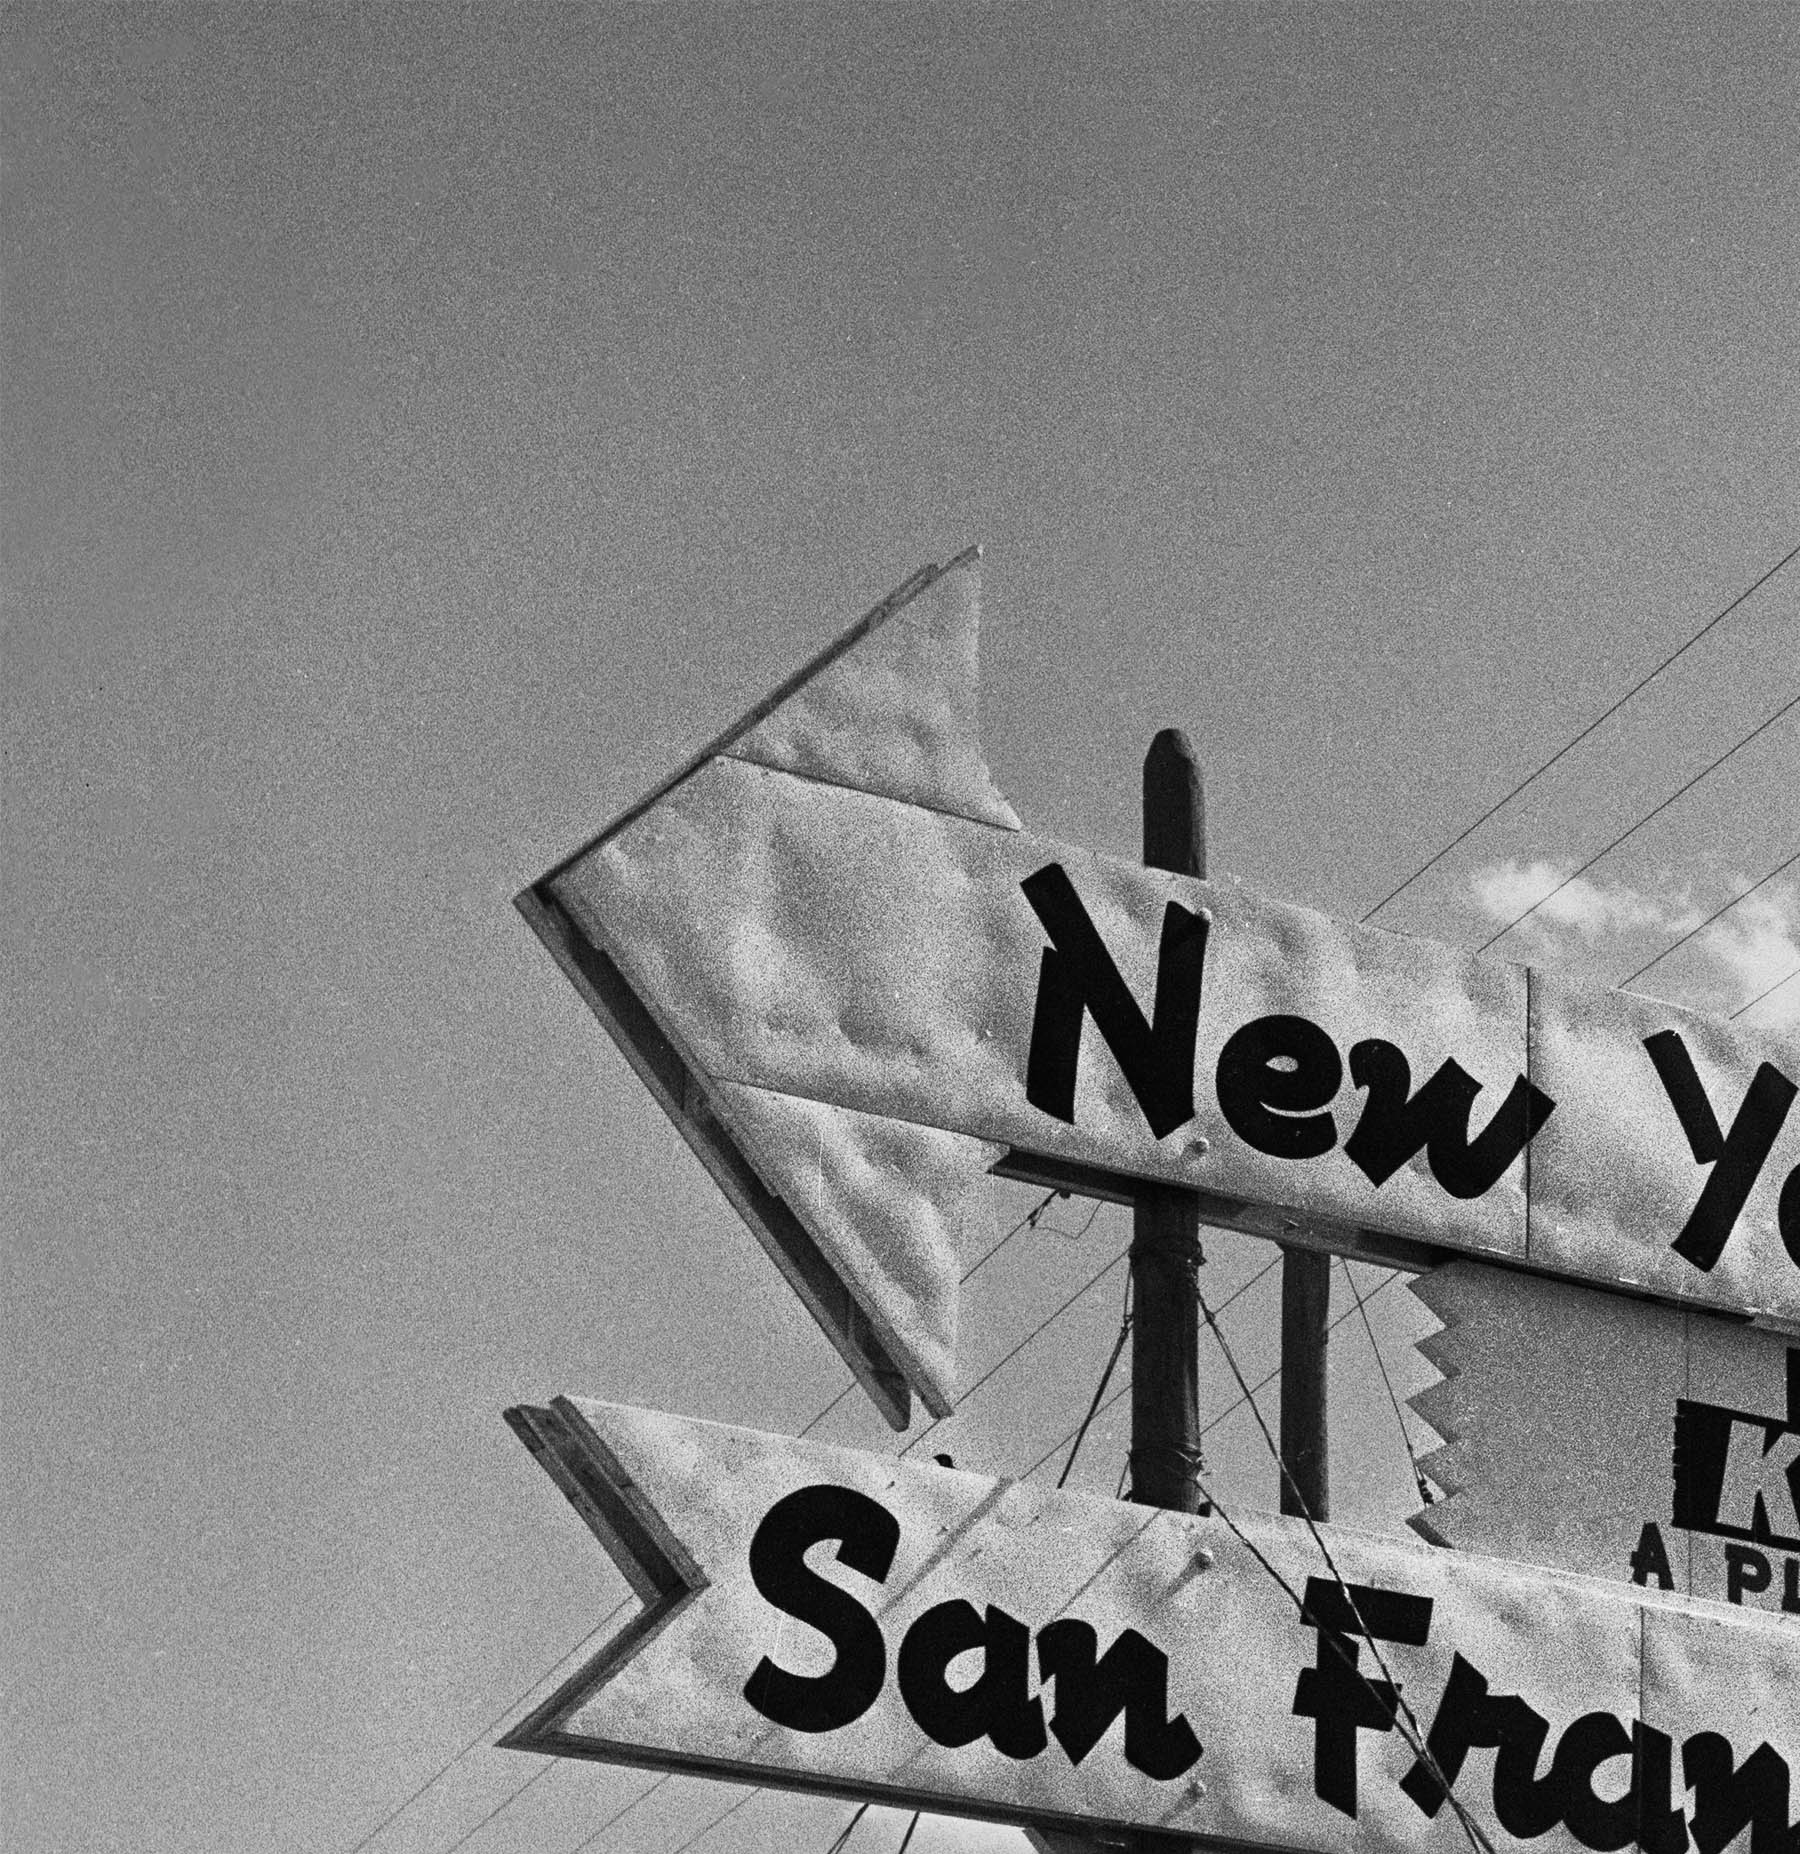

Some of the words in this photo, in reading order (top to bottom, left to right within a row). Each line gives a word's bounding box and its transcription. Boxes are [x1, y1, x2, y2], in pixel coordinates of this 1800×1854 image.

[1019, 862, 1557, 1199] New
[743, 1484, 1202, 1781] San
[1631, 1522, 1674, 1591] A
